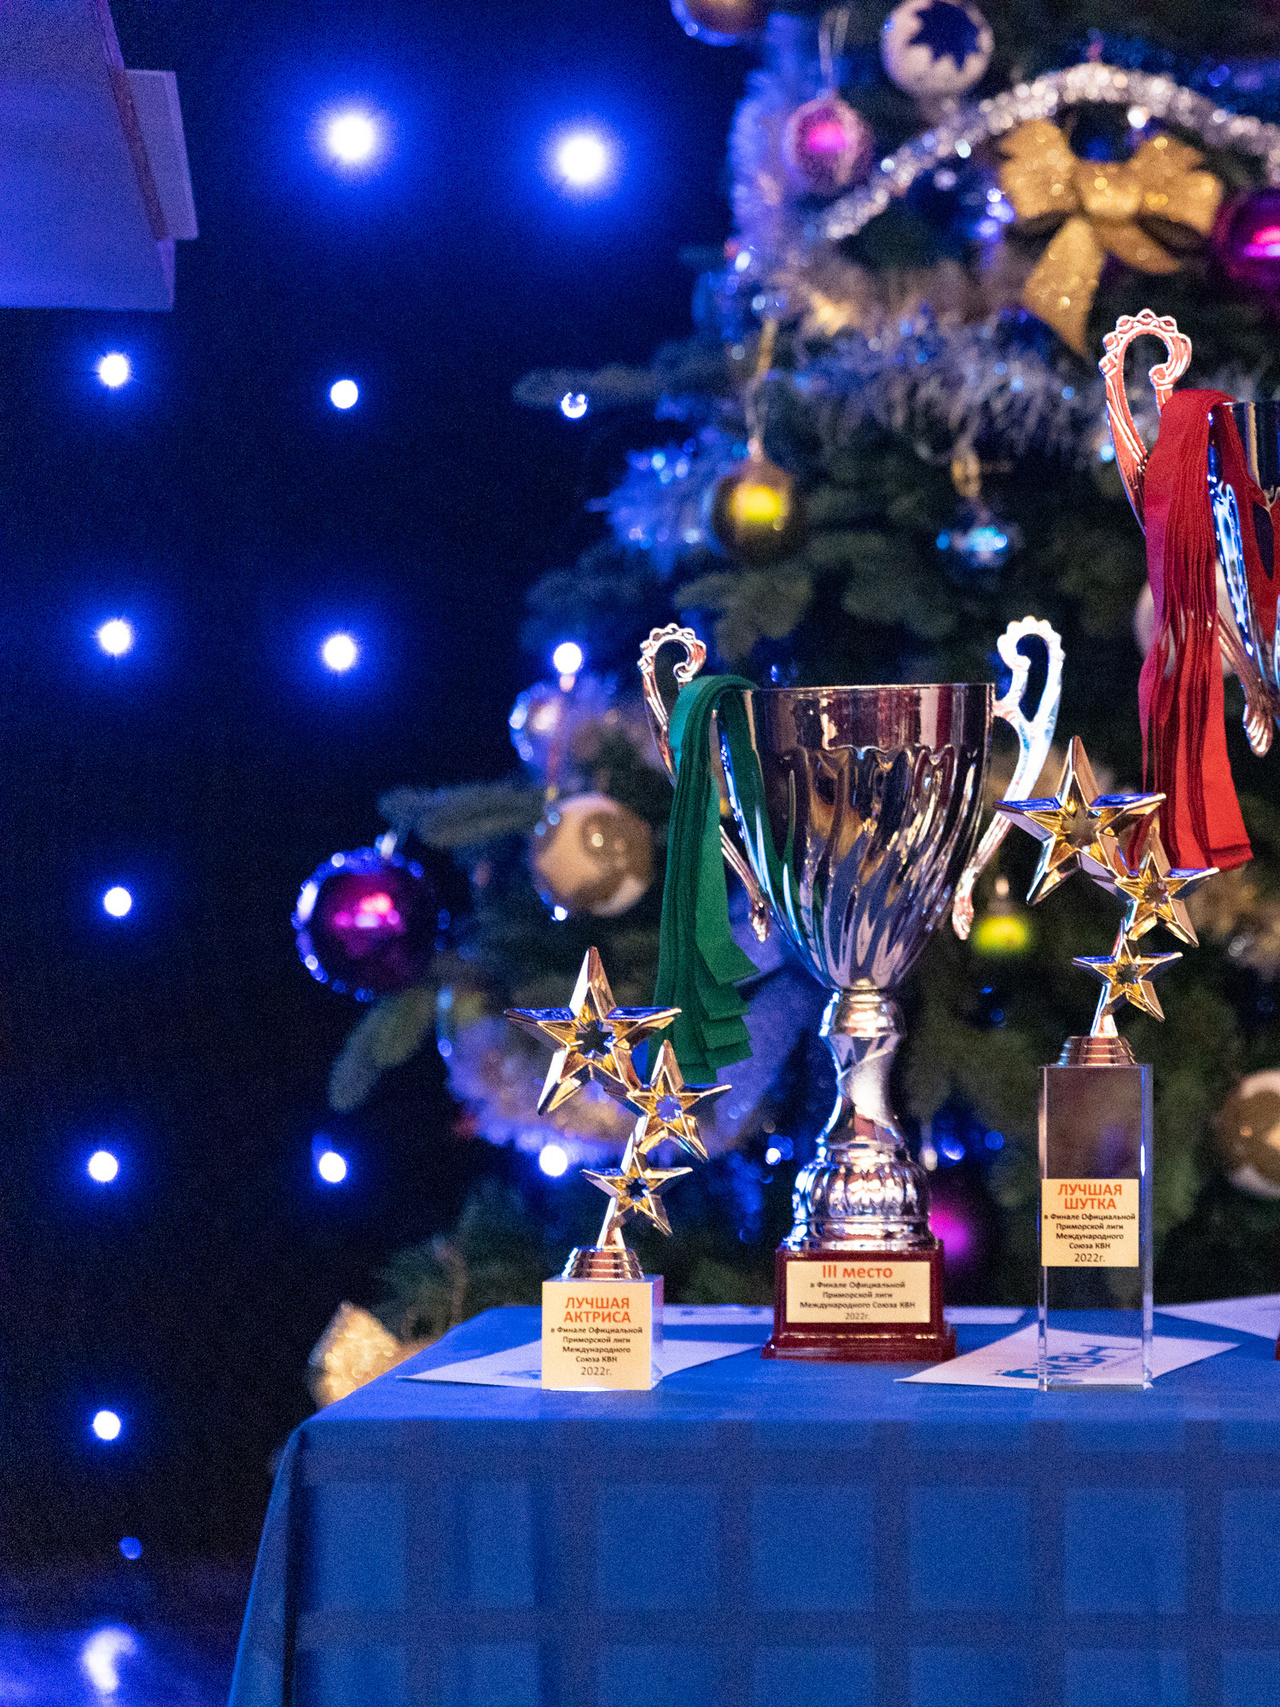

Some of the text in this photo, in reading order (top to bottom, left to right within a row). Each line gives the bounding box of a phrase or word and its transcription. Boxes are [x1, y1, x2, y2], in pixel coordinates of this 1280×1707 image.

[1058, 1184, 1122, 1196] ЛУЧШАЯ
[1064, 1198, 1116, 1209] ШУТКА
[1074, 1253, 1105, 1262] 2022г.
[842, 1267, 893, 1278] место
[565, 1297, 630, 1309] ЛУЧШАЯ
[564, 1311, 631, 1323] АКТРИСА
[581, 1367, 612, 1375] 2022г.
